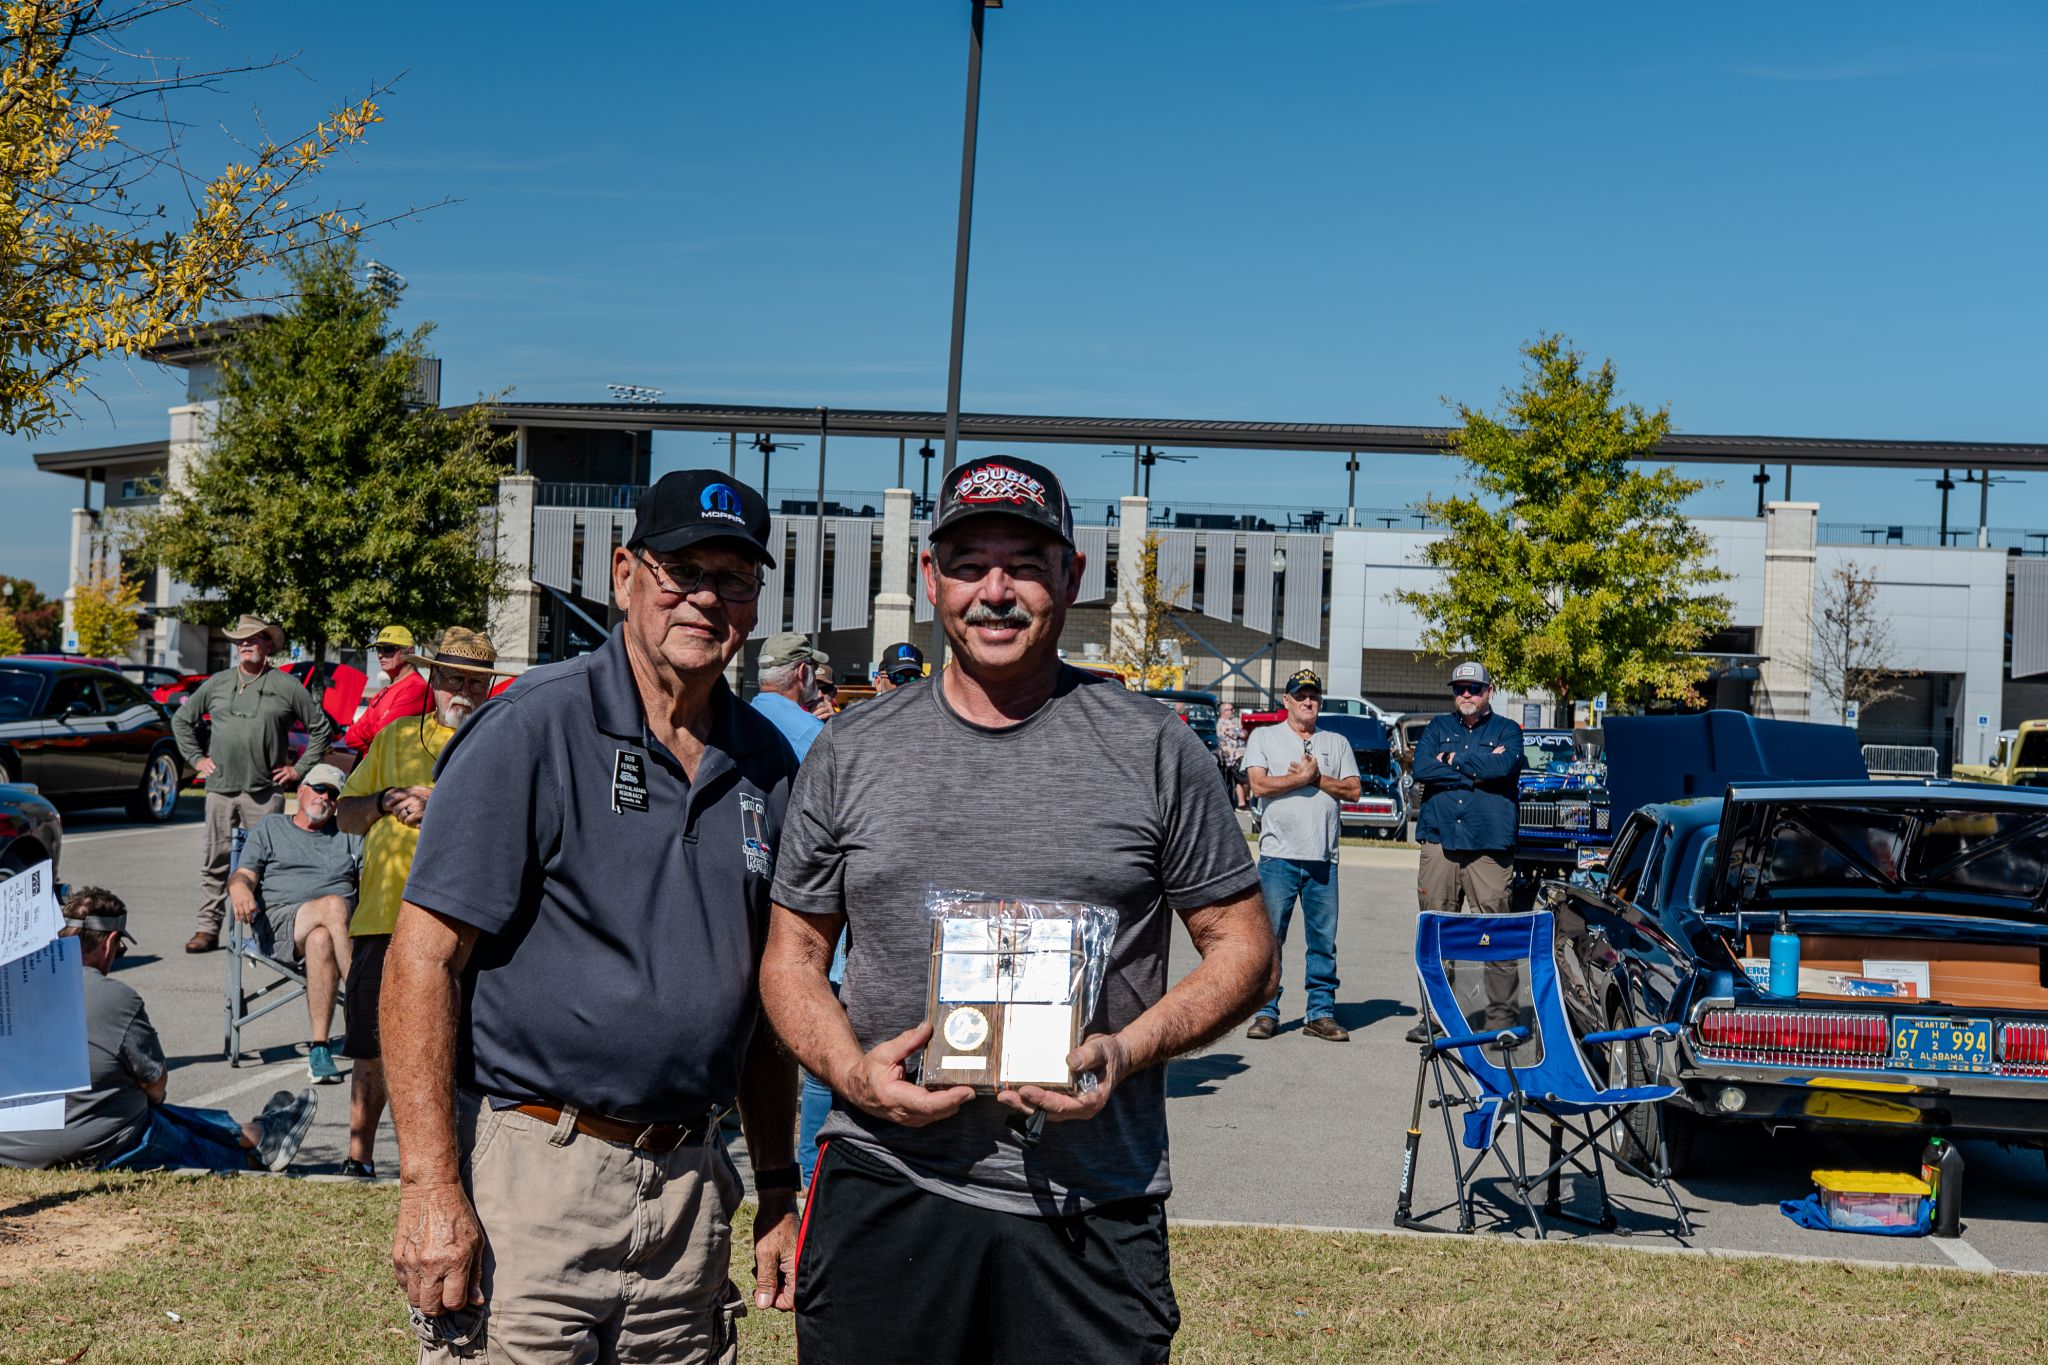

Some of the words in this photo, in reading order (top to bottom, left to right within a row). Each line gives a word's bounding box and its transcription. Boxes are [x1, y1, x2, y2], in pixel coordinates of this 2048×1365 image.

[958, 466, 1043, 494] DOUBLE
[981, 480, 1016, 496] XX
[701, 511, 744, 525] MOPAR
[624, 755, 635, 763] BOB
[620, 763, 638, 772] FERENC
[1915, 1021, 1938, 1029] HEART
[1897, 1028, 1919, 1049] 67
[1931, 1030, 1940, 1039] H
[1931, 1041, 1939, 1050] 2
[1952, 1031, 1986, 1052] 994
[1920, 1052, 1964, 1061] ALABAMA
[1972, 1054, 1984, 1063] 67
